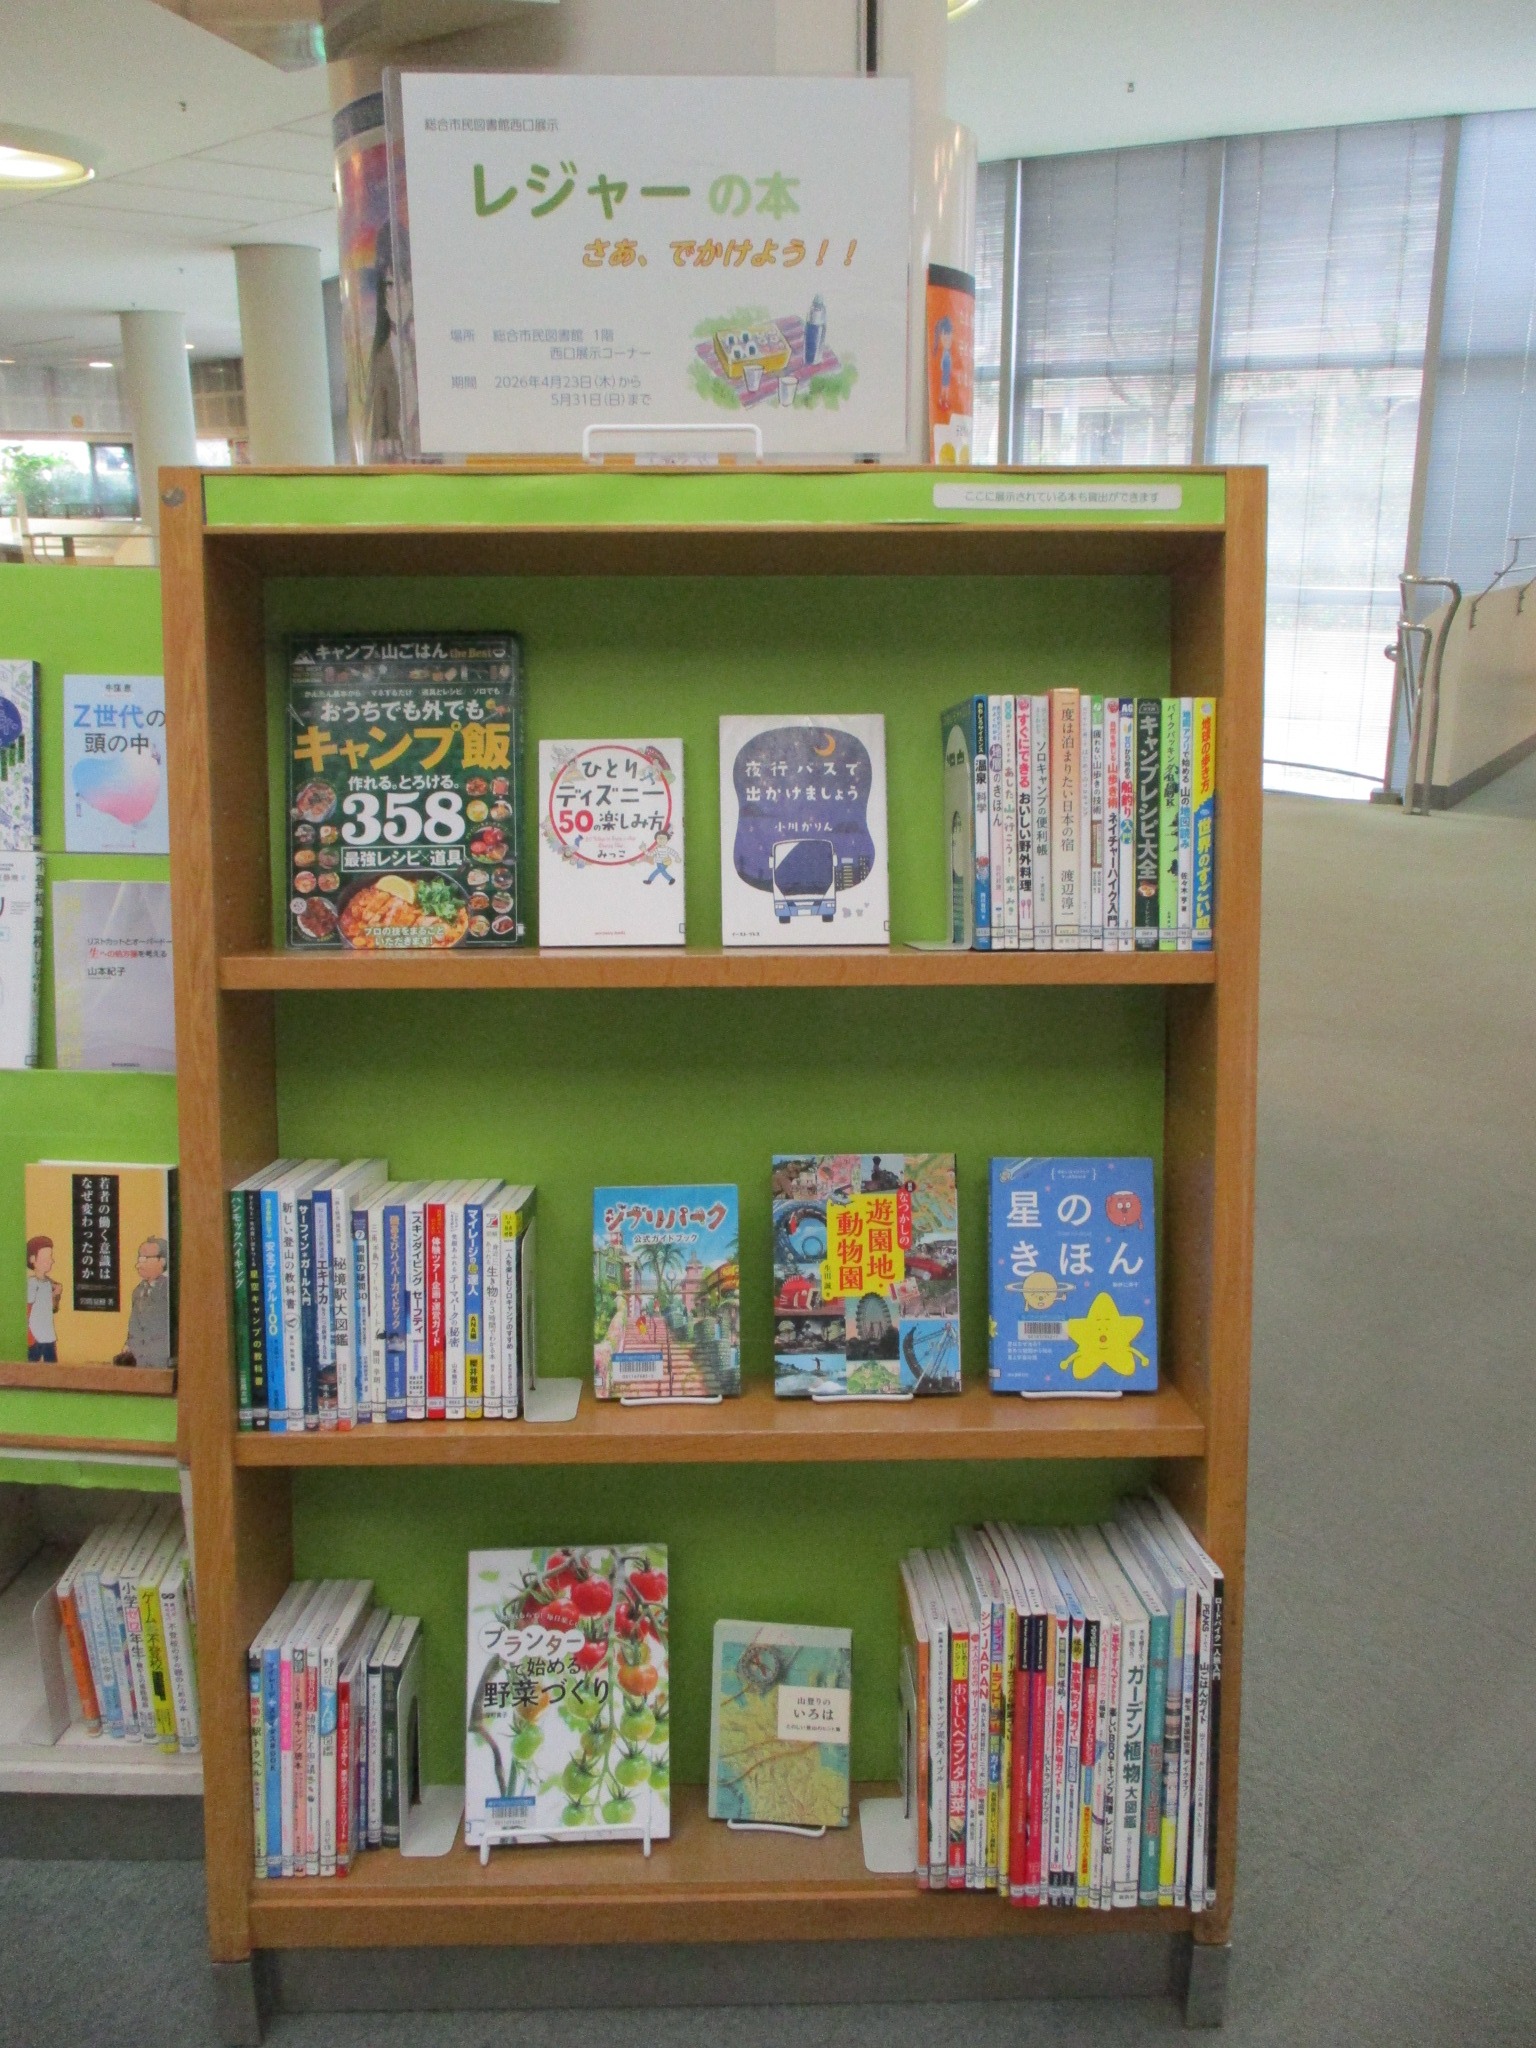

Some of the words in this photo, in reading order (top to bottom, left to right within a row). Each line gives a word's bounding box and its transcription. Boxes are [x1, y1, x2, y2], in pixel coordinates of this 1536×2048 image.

[425, 118, 559, 132] 総合市民図書館西口展示
[473, 161, 801, 219] レジャーの本
[450, 329, 475, 342] 場所
[493, 329, 584, 342] 総合市民図書館
[550, 346, 652, 360] 西口展示コーナー
[451, 376, 477, 389] 期間
[73, 704, 166, 730] Z世代の
[320, 700, 485, 722] おうちでも外でも
[85, 733, 150, 757] 頭の中
[293, 721, 512, 773] キャンプ飯
[582, 758, 638, 779] ひとり
[745, 760, 862, 778] 夜行バスで
[1060, 701, 1075, 852] 一度は泊まりたい日本の宿
[556, 785, 665, 808] ディズニー
[745, 785, 859, 802] 出かけましょう
[1035, 741, 1049, 856] ソロキャンプの便利帳
[1137, 715, 1160, 880] キャンプレシピ大全
[341, 791, 466, 845] 358
[558, 809, 665, 834] 50の楽しみ方
[774, 821, 834, 833] 小川かりん
[1018, 792, 1032, 892] おいしい野外料理
[1106, 812, 1118, 928] ネイチャーハイク入門
[1060, 870, 1075, 917] 渡辺淳一
[81, 1176, 94, 1280] なぜ変わったのか
[98, 1176, 111, 1280] 若者の働く意識は
[604, 1200, 728, 1232] ジブリパーク
[898, 1191, 911, 1245] なつかしの
[231, 1196, 245, 1290] ハンモックハイキング
[281, 1201, 297, 1310] 新しい登山の教科書
[633, 1234, 698, 1244] 公式ガイドブック
[836, 1210, 864, 1292] 動物園
[1010, 1240, 1144, 1277] きほん
[316, 1260, 329, 1305] エキナカ
[332, 1256, 349, 1347] 秘境駅大図鑑
[484, 1626, 582, 1657] プランター
[483, 1676, 610, 1709] 野菜づくり
[797, 1696, 831, 1706] 山登りの
[793, 1708, 835, 1721] いろは
[1123, 1664, 1146, 1829] ガーデン植物大図鑑
